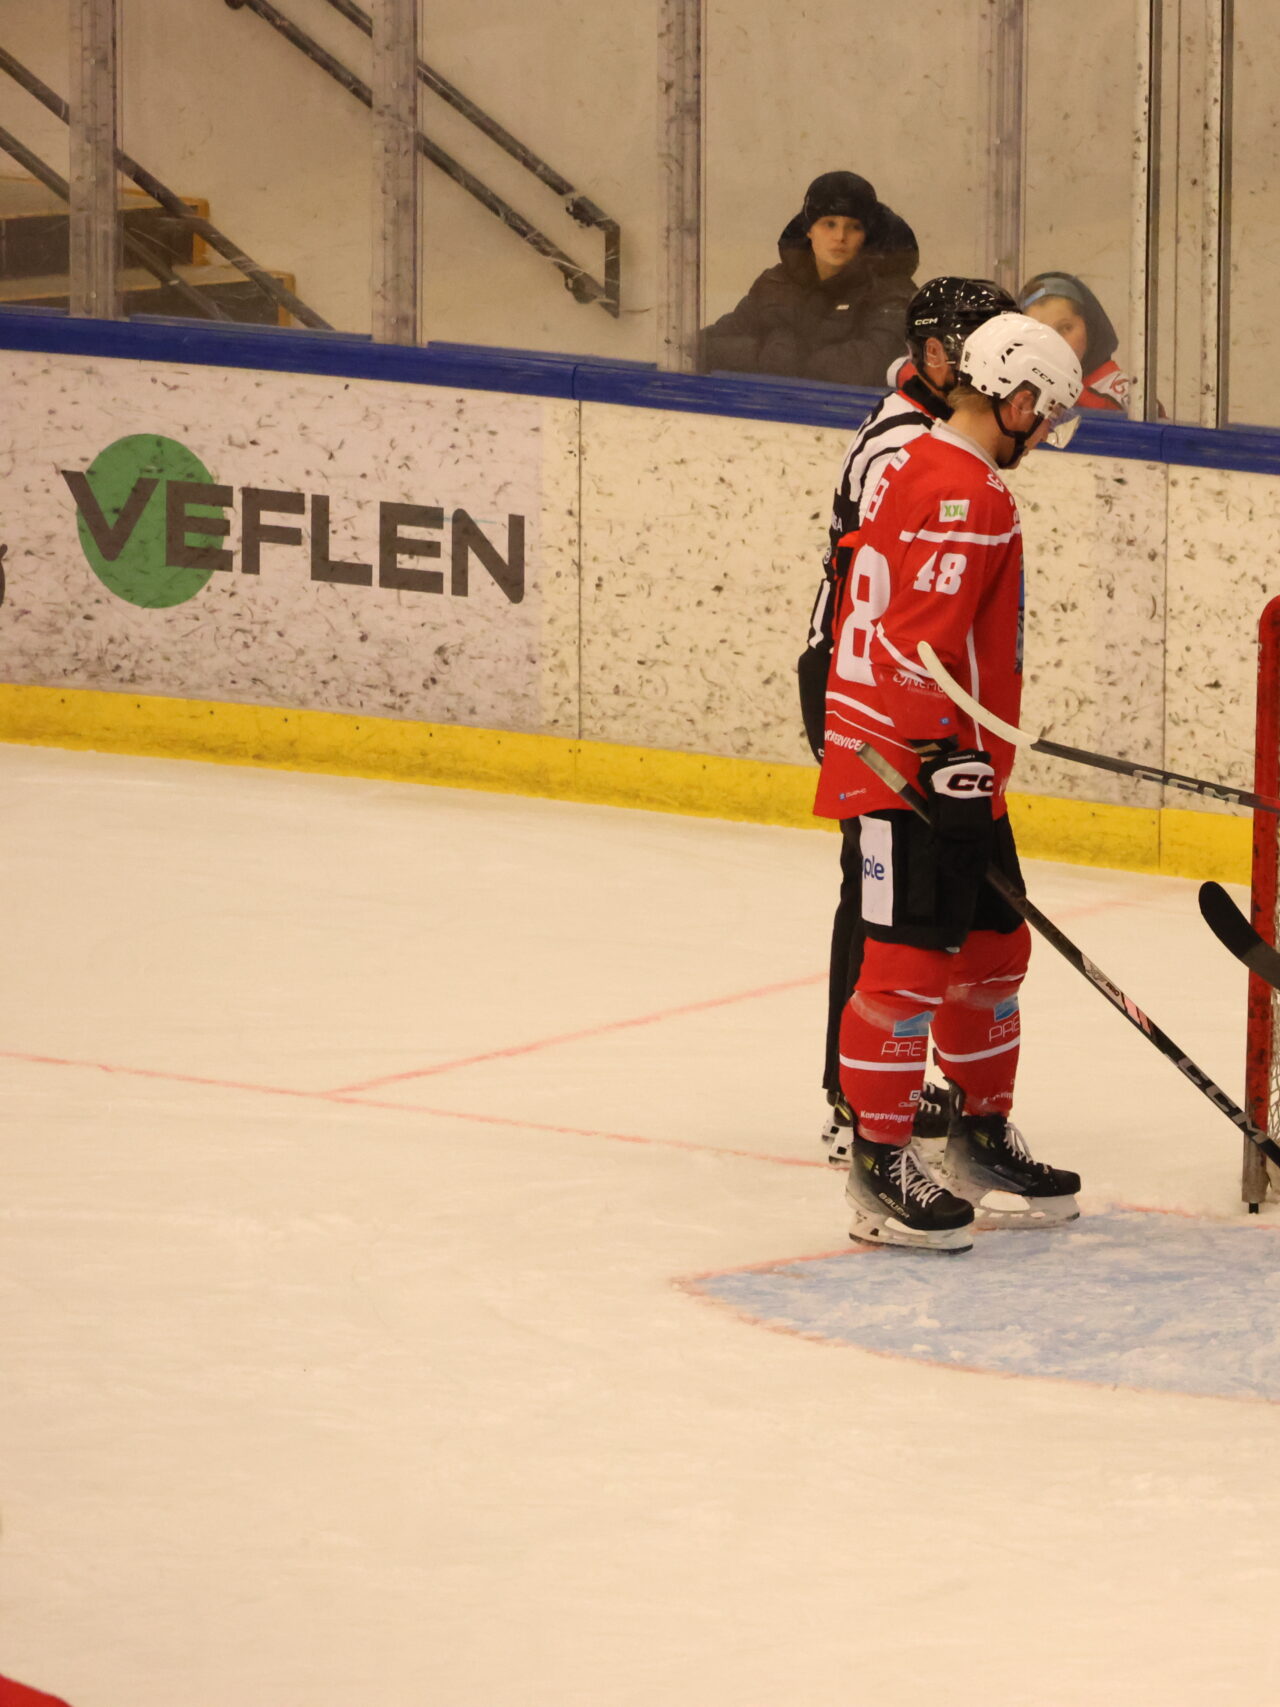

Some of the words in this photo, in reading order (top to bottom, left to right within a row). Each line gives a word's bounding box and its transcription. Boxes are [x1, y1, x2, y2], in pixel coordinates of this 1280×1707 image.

[914, 317, 938, 326] CCM
[1032, 367, 1055, 385] CCM
[944, 504, 965, 517] XXL
[61, 469, 526, 604] VEFLEN
[912, 550, 967, 595] 48
[947, 773, 995, 792] CC
[1178, 1056, 1270, 1144] CCM
